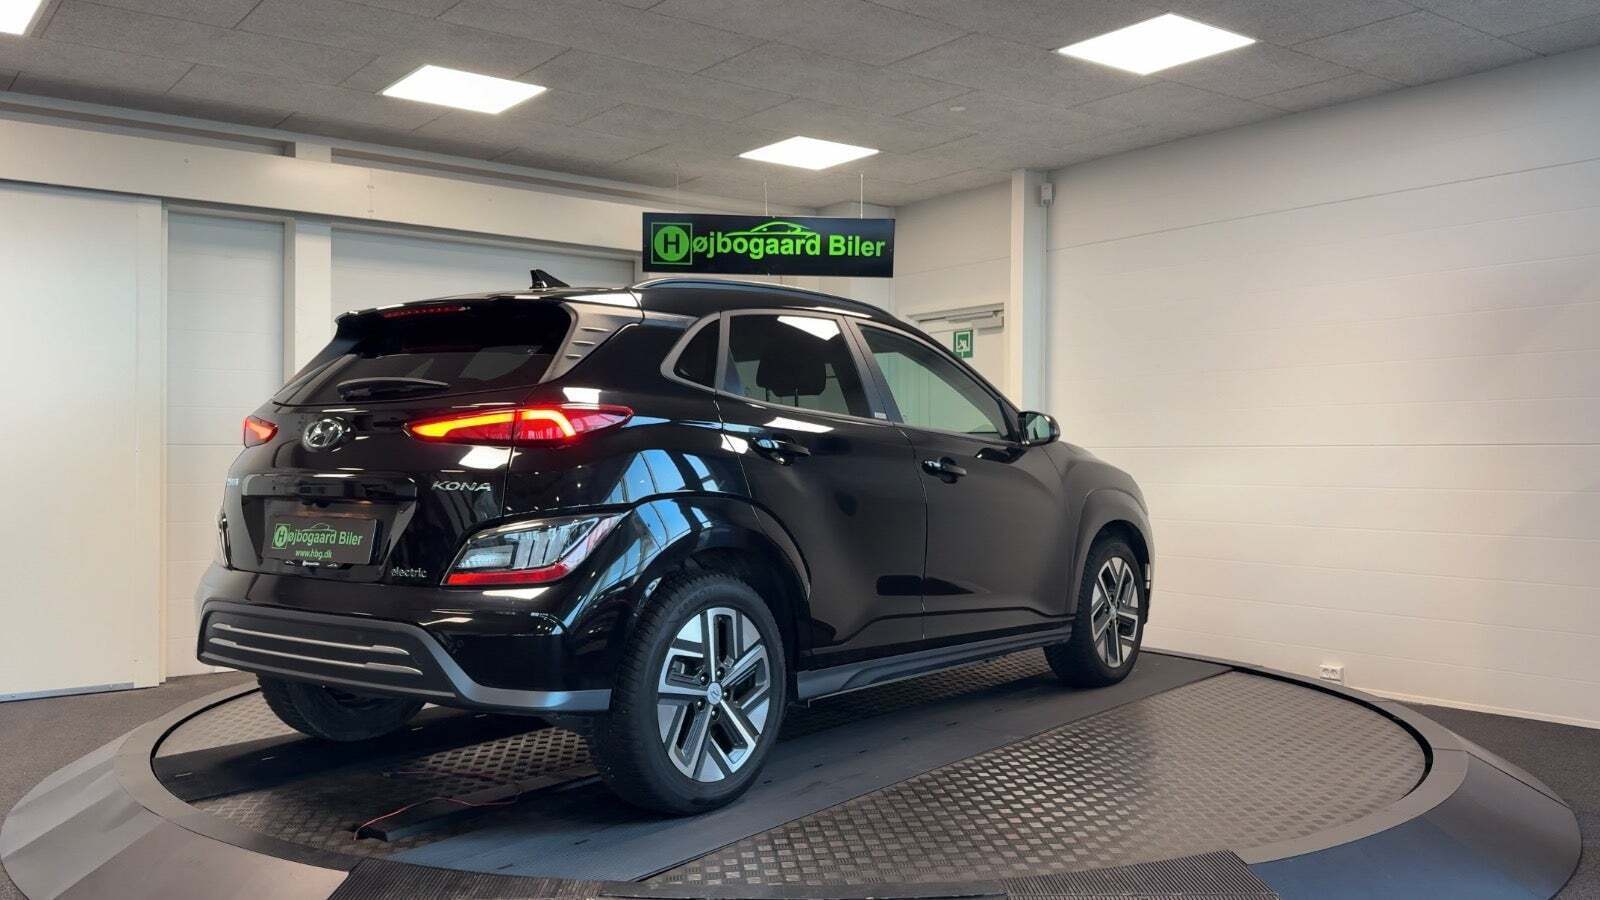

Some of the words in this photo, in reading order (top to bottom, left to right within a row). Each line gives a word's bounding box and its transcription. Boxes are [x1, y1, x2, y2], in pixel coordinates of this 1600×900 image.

[654, 226, 820, 260] Højbogaard
[829, 235, 886, 256] Biler
[431, 481, 491, 491] KONA
[338, 531, 363, 546] Biler
[295, 548, 332, 560] www.hbg.dk
[391, 566, 427, 578] electric
